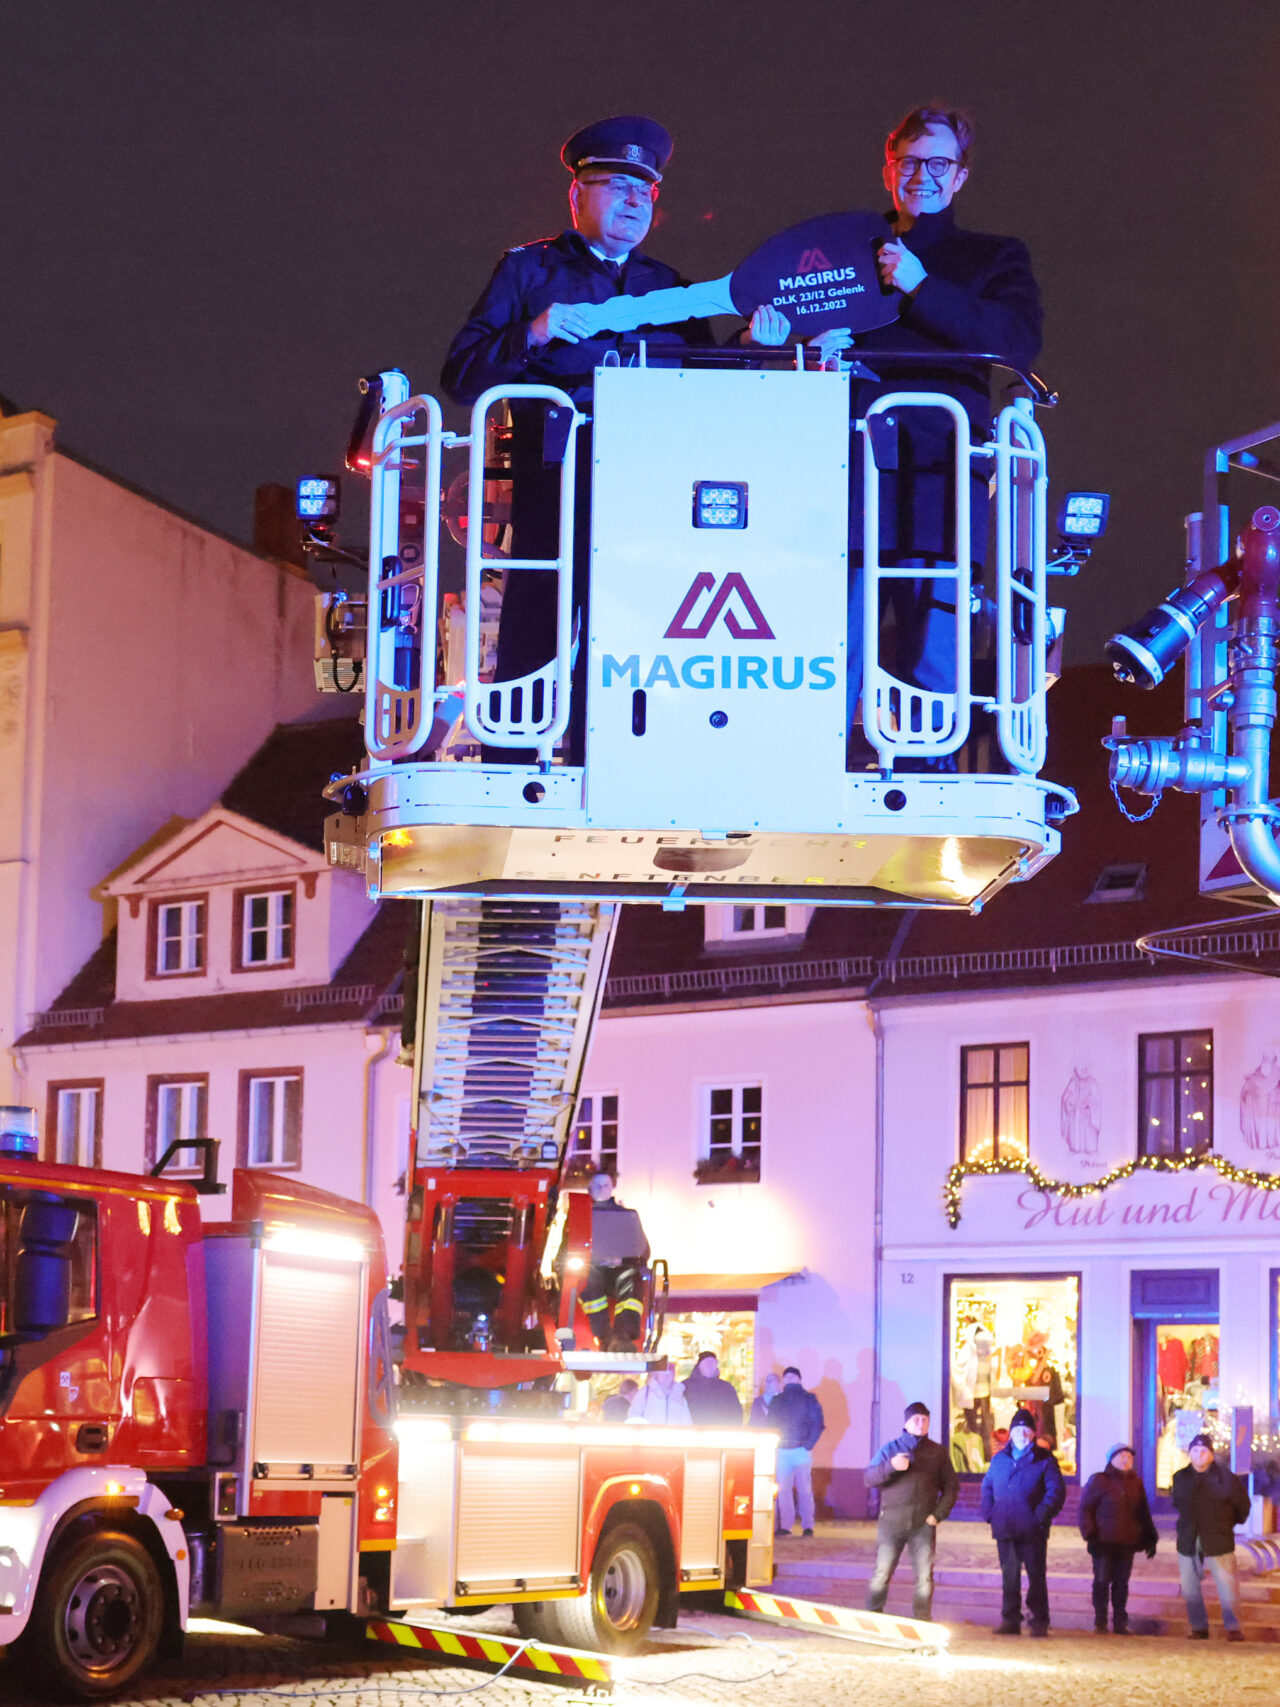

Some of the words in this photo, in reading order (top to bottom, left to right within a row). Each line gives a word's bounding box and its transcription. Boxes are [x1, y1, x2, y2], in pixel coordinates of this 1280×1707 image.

[779, 267, 856, 290] MAGIRUS
[773, 294, 798, 306] DLK
[799, 290, 825, 302] 23/12
[827, 284, 865, 297] Gelenk
[796, 299, 847, 315] 16.12.2023
[602, 654, 836, 690] MAGIRUS
[1016, 1187, 1115, 1229] Hut
[1122, 1186, 1205, 1225] und
[901, 1272, 914, 1284] 12
